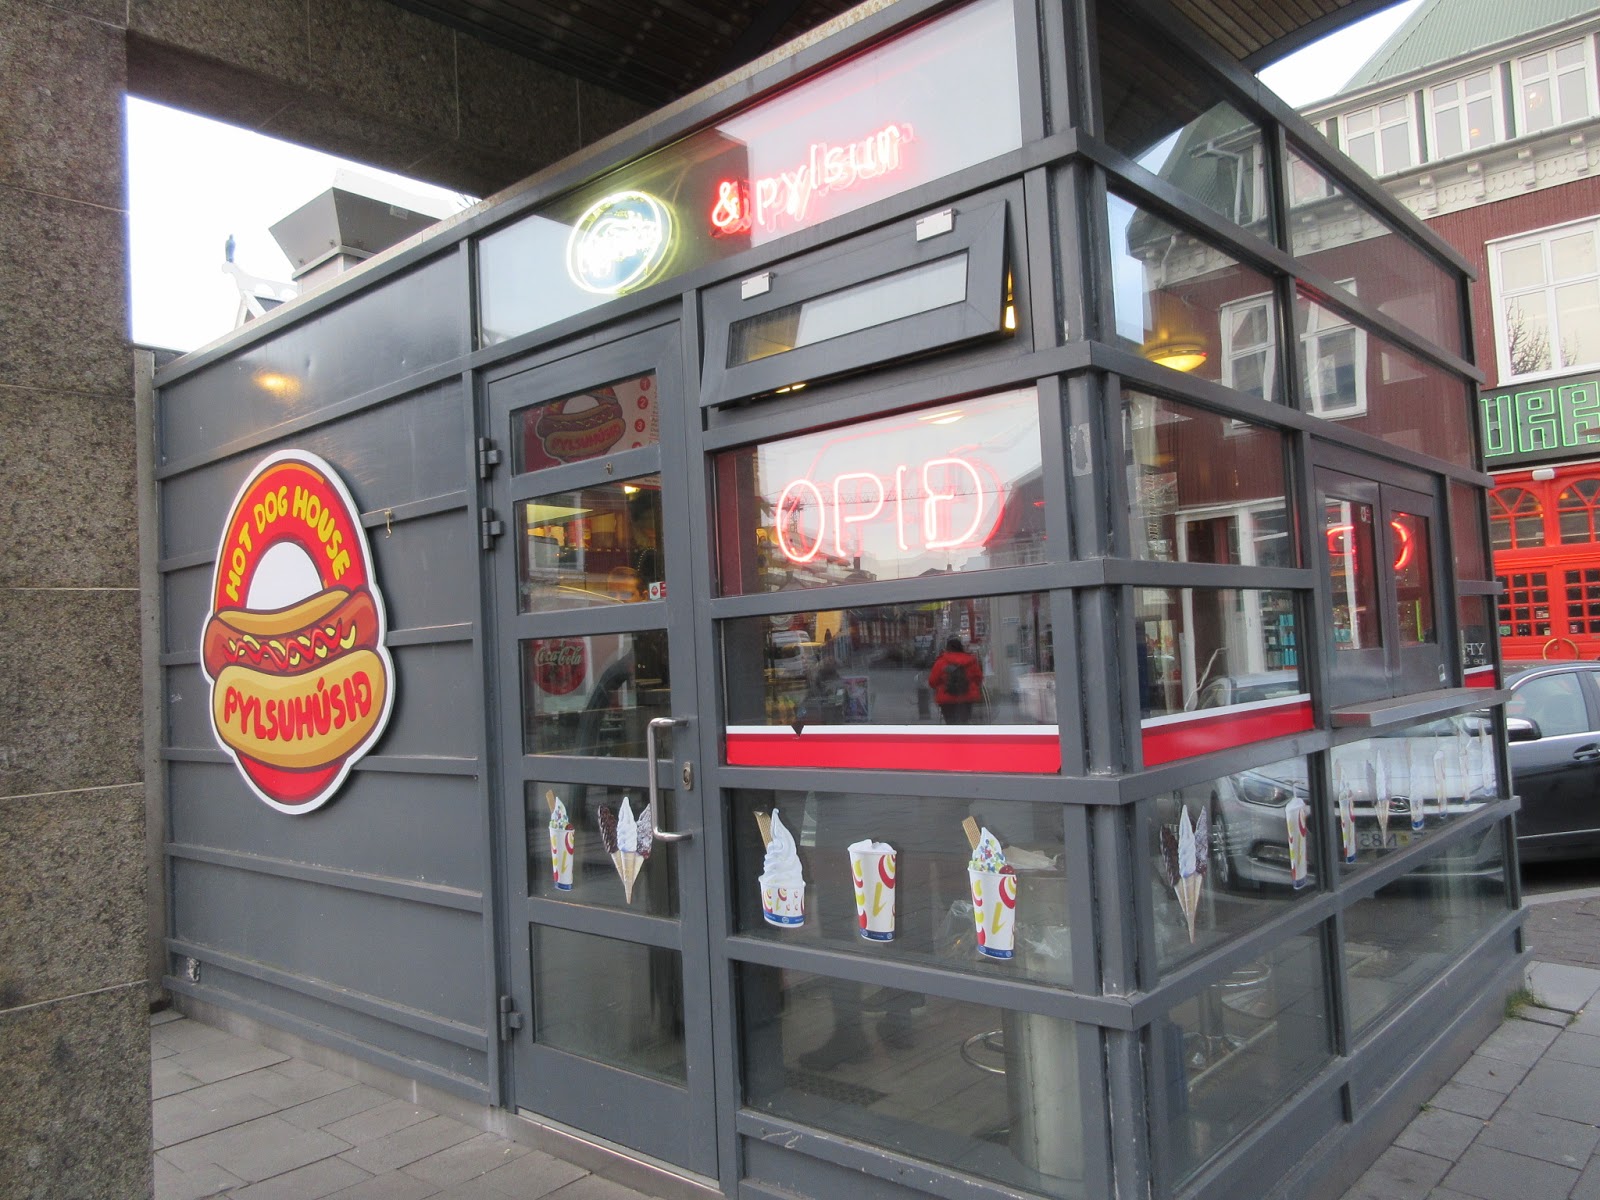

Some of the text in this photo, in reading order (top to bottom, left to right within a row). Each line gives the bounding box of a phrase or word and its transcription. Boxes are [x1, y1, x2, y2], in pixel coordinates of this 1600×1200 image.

[226, 485, 351, 602] HOT DOG HOUSE
[224, 670, 372, 742] PYLSUHÚSIÐ
